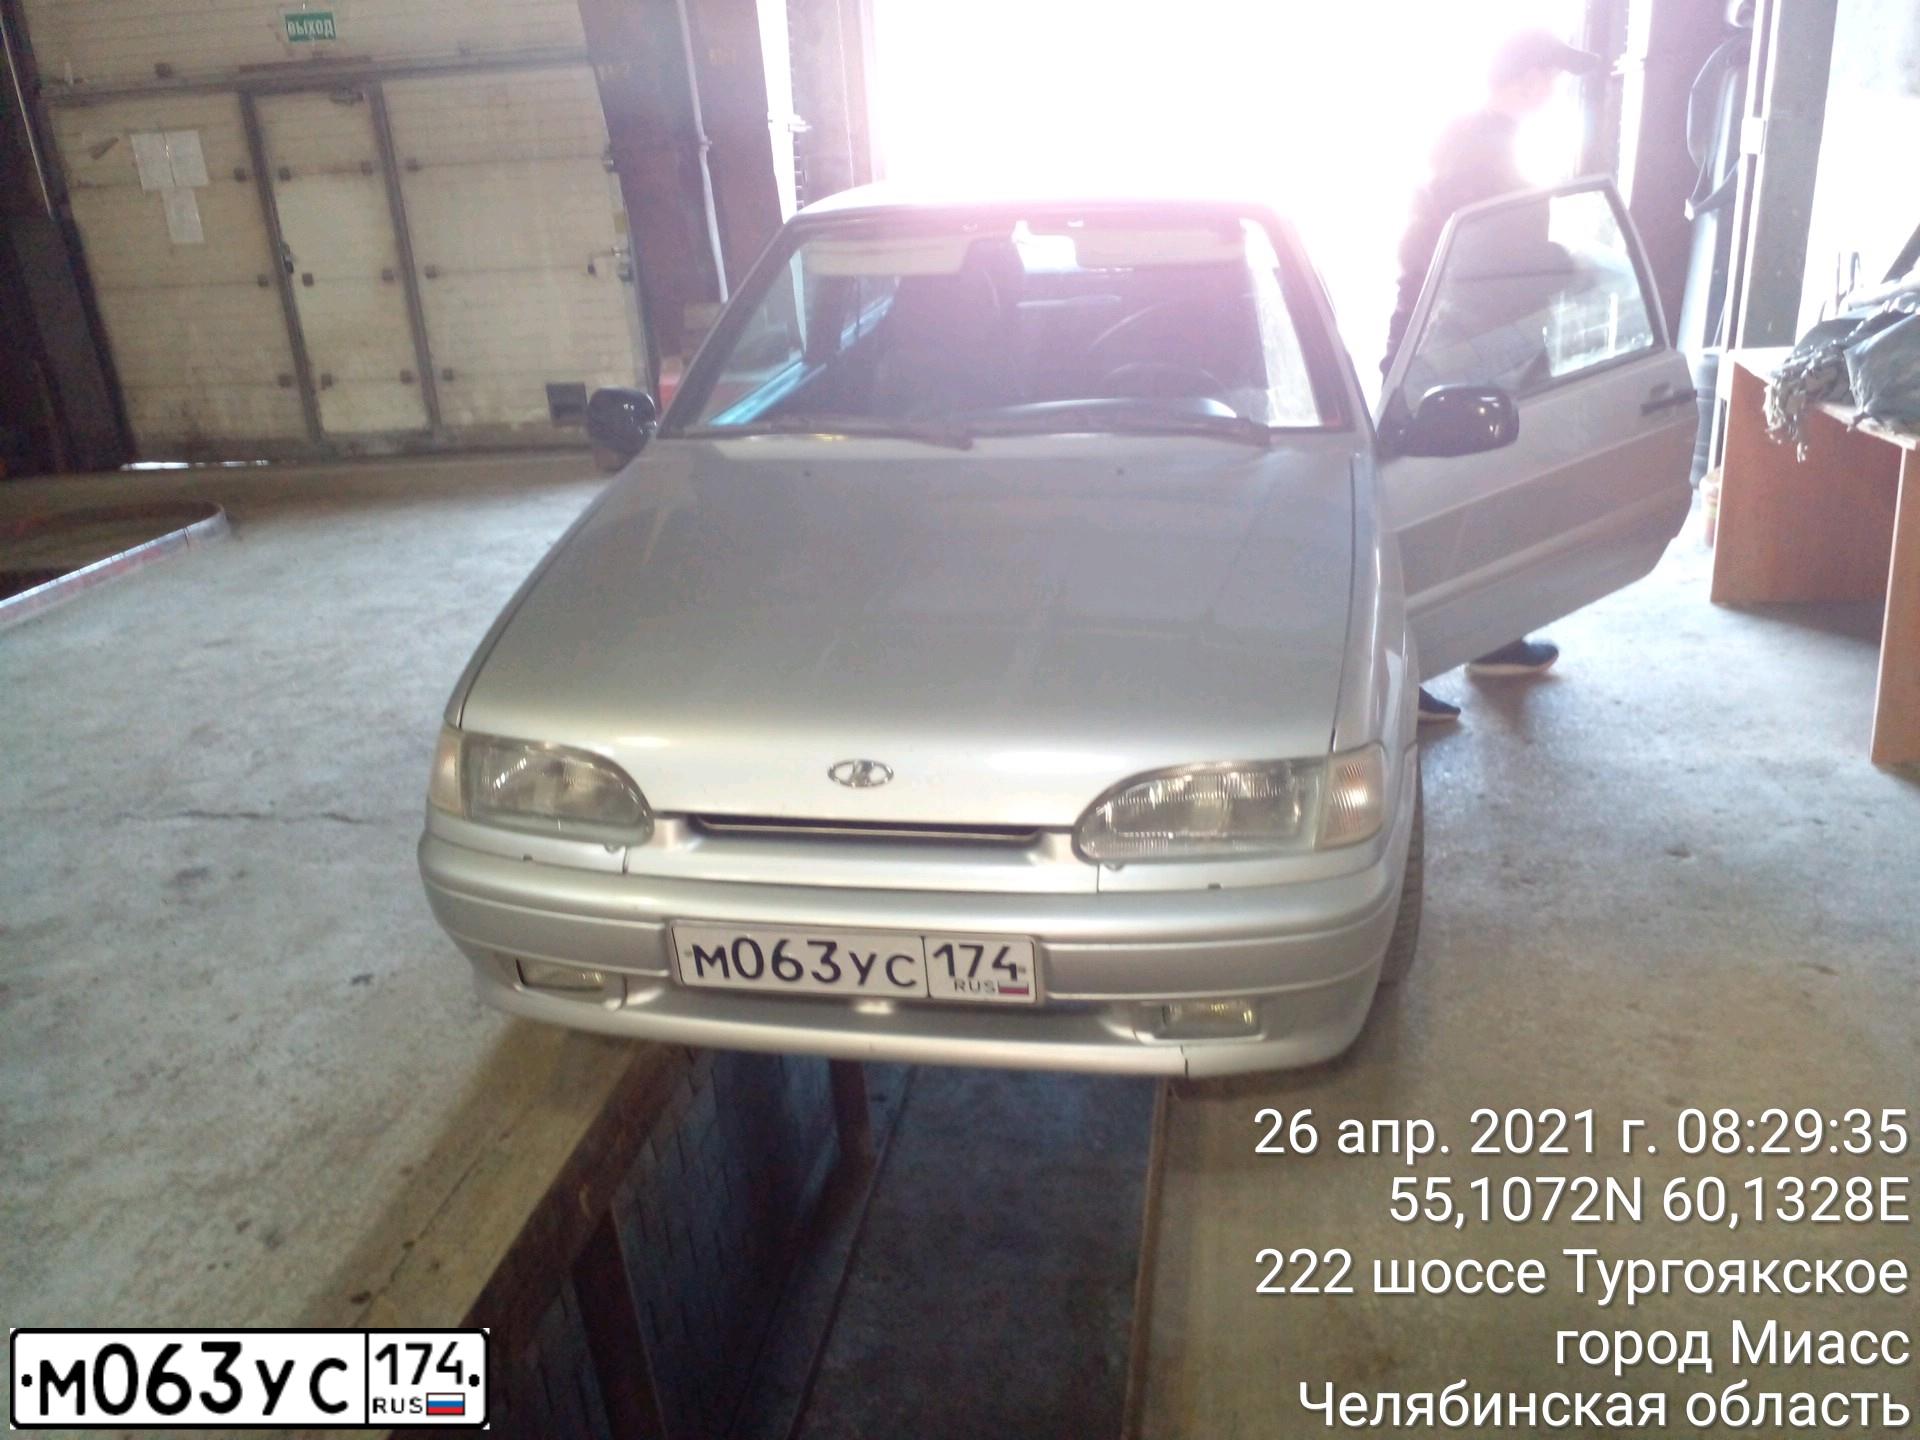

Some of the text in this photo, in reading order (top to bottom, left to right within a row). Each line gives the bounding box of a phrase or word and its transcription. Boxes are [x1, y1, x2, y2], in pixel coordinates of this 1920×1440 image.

[287, 18, 335, 38] ВЫХОД
[691, 936, 1019, 988] М063УС 174
[953, 977, 996, 994] RUS
